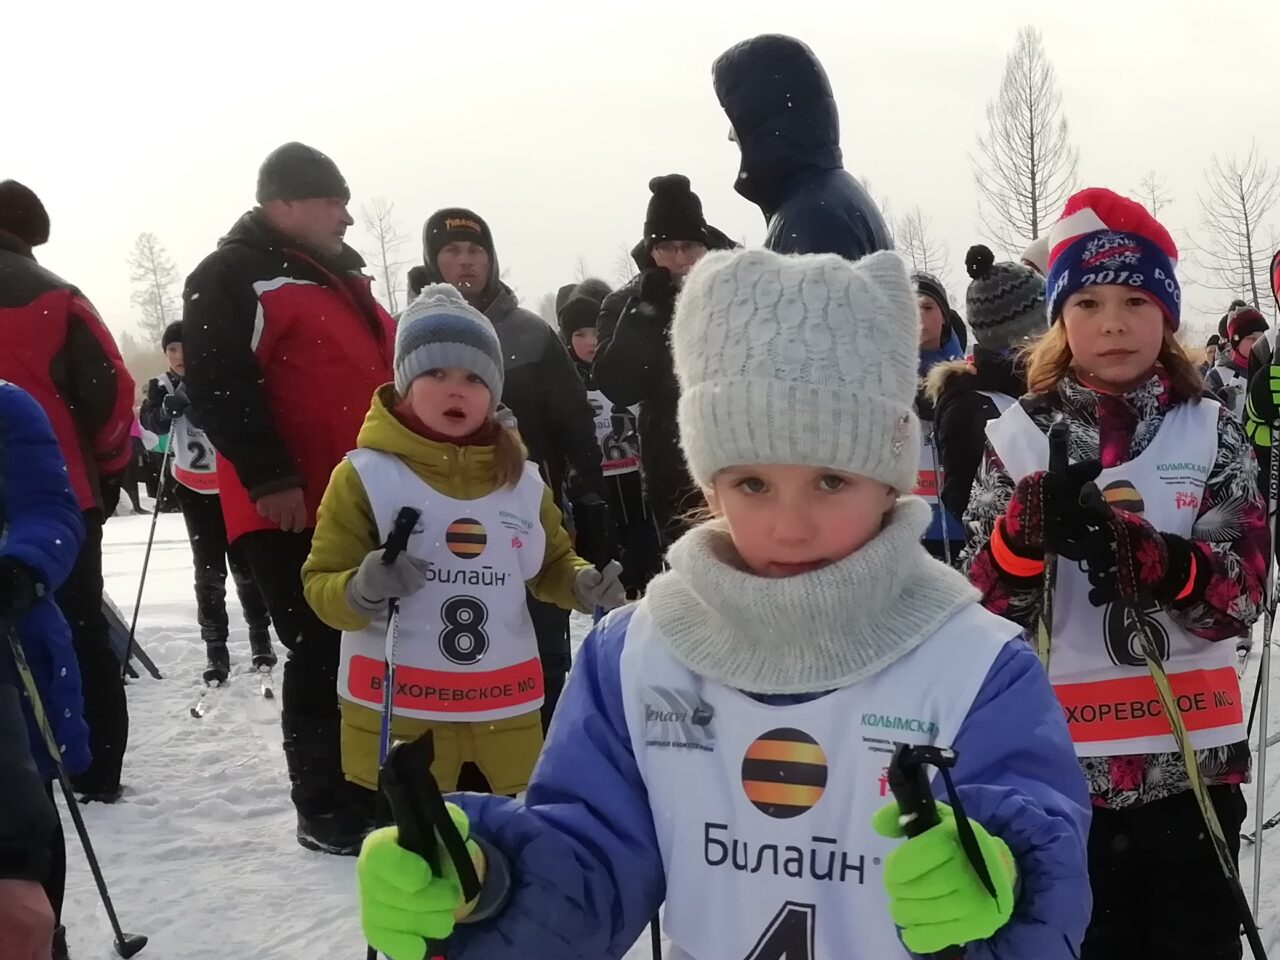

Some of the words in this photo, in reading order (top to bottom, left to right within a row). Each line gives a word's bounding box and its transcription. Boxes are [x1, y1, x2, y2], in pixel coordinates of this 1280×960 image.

[1081, 270, 1144, 287] 2018
[186, 441, 211, 471] 2
[1270, 436, 1280, 501] NORDWAY
[438, 594, 490, 666] 8
[370, 676, 513, 701] ВХОРЕВСКОЕ
[517, 676, 537, 694] МО
[1066, 692, 1207, 724] ХОРЕВСОЕ
[704, 822, 865, 885] Билайн
